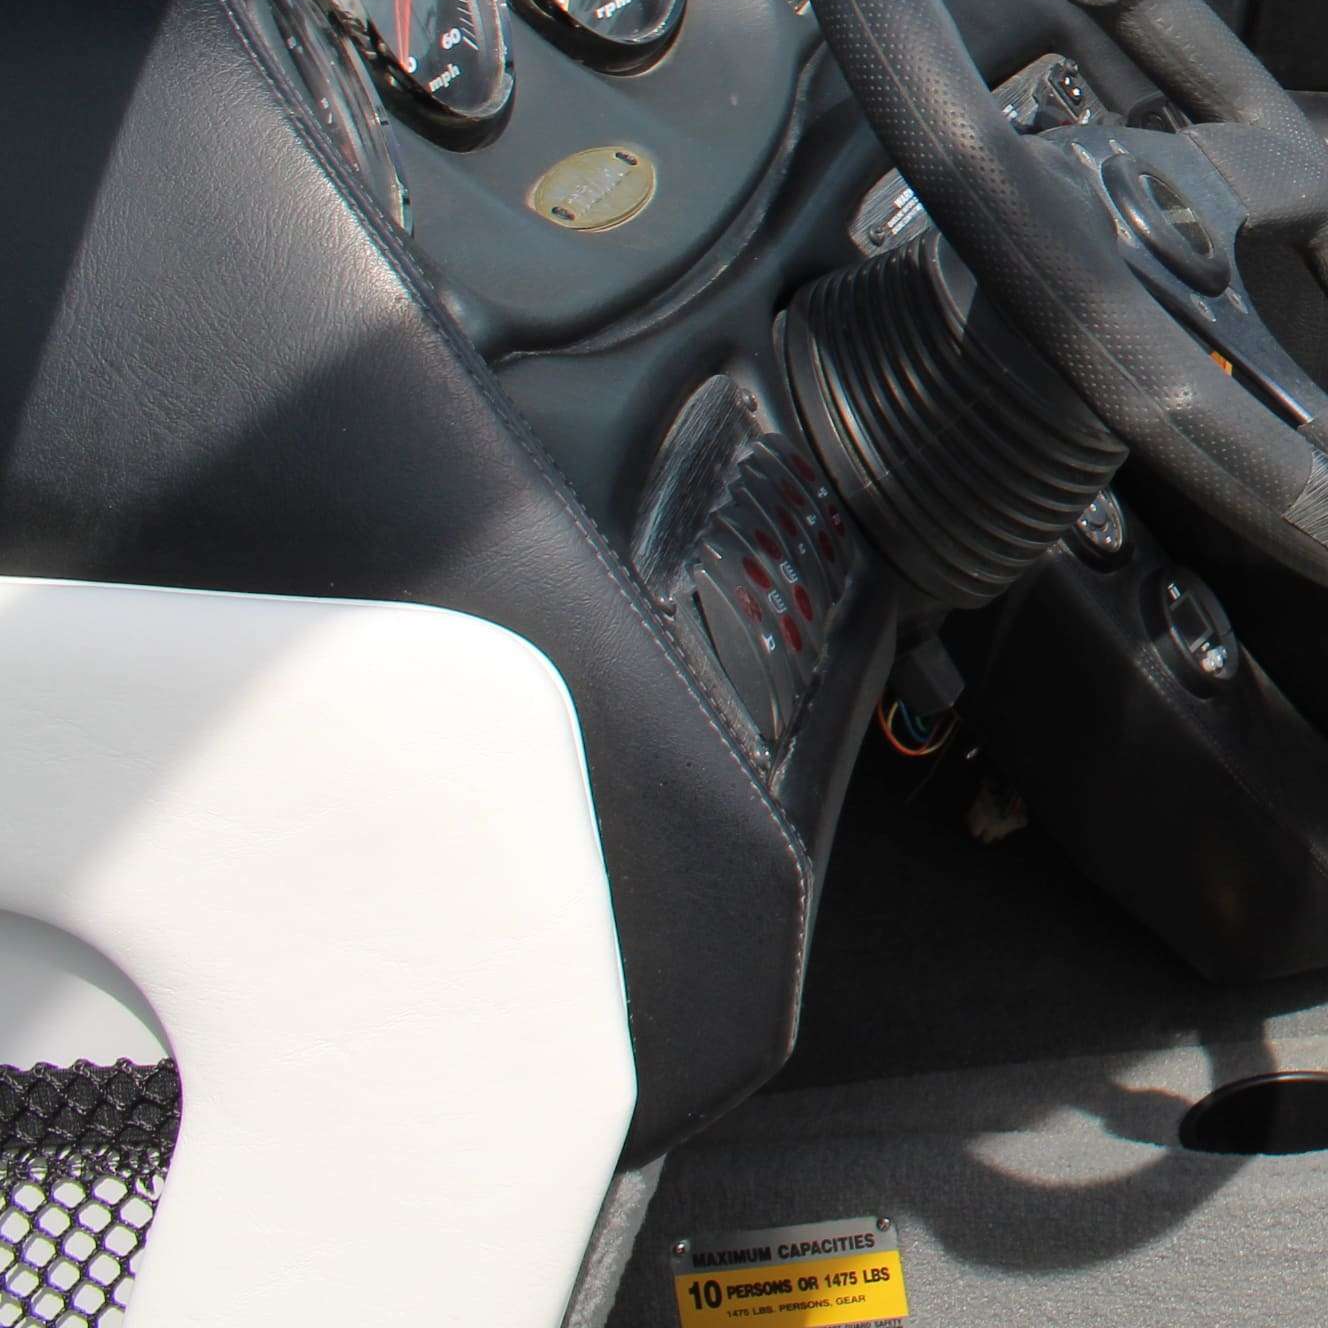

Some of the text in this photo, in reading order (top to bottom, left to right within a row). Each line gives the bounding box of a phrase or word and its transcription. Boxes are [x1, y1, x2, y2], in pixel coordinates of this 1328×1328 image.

[442, 28, 461, 50] 60
[428, 63, 460, 92] mph
[692, 1233, 876, 1268] MAXIMUM CAPACITIES
[688, 1266, 891, 1310] 10 PERSONS OR 1475 LBS
[727, 1308, 750, 1319] 1475
[835, 1294, 866, 1307] GEAR
